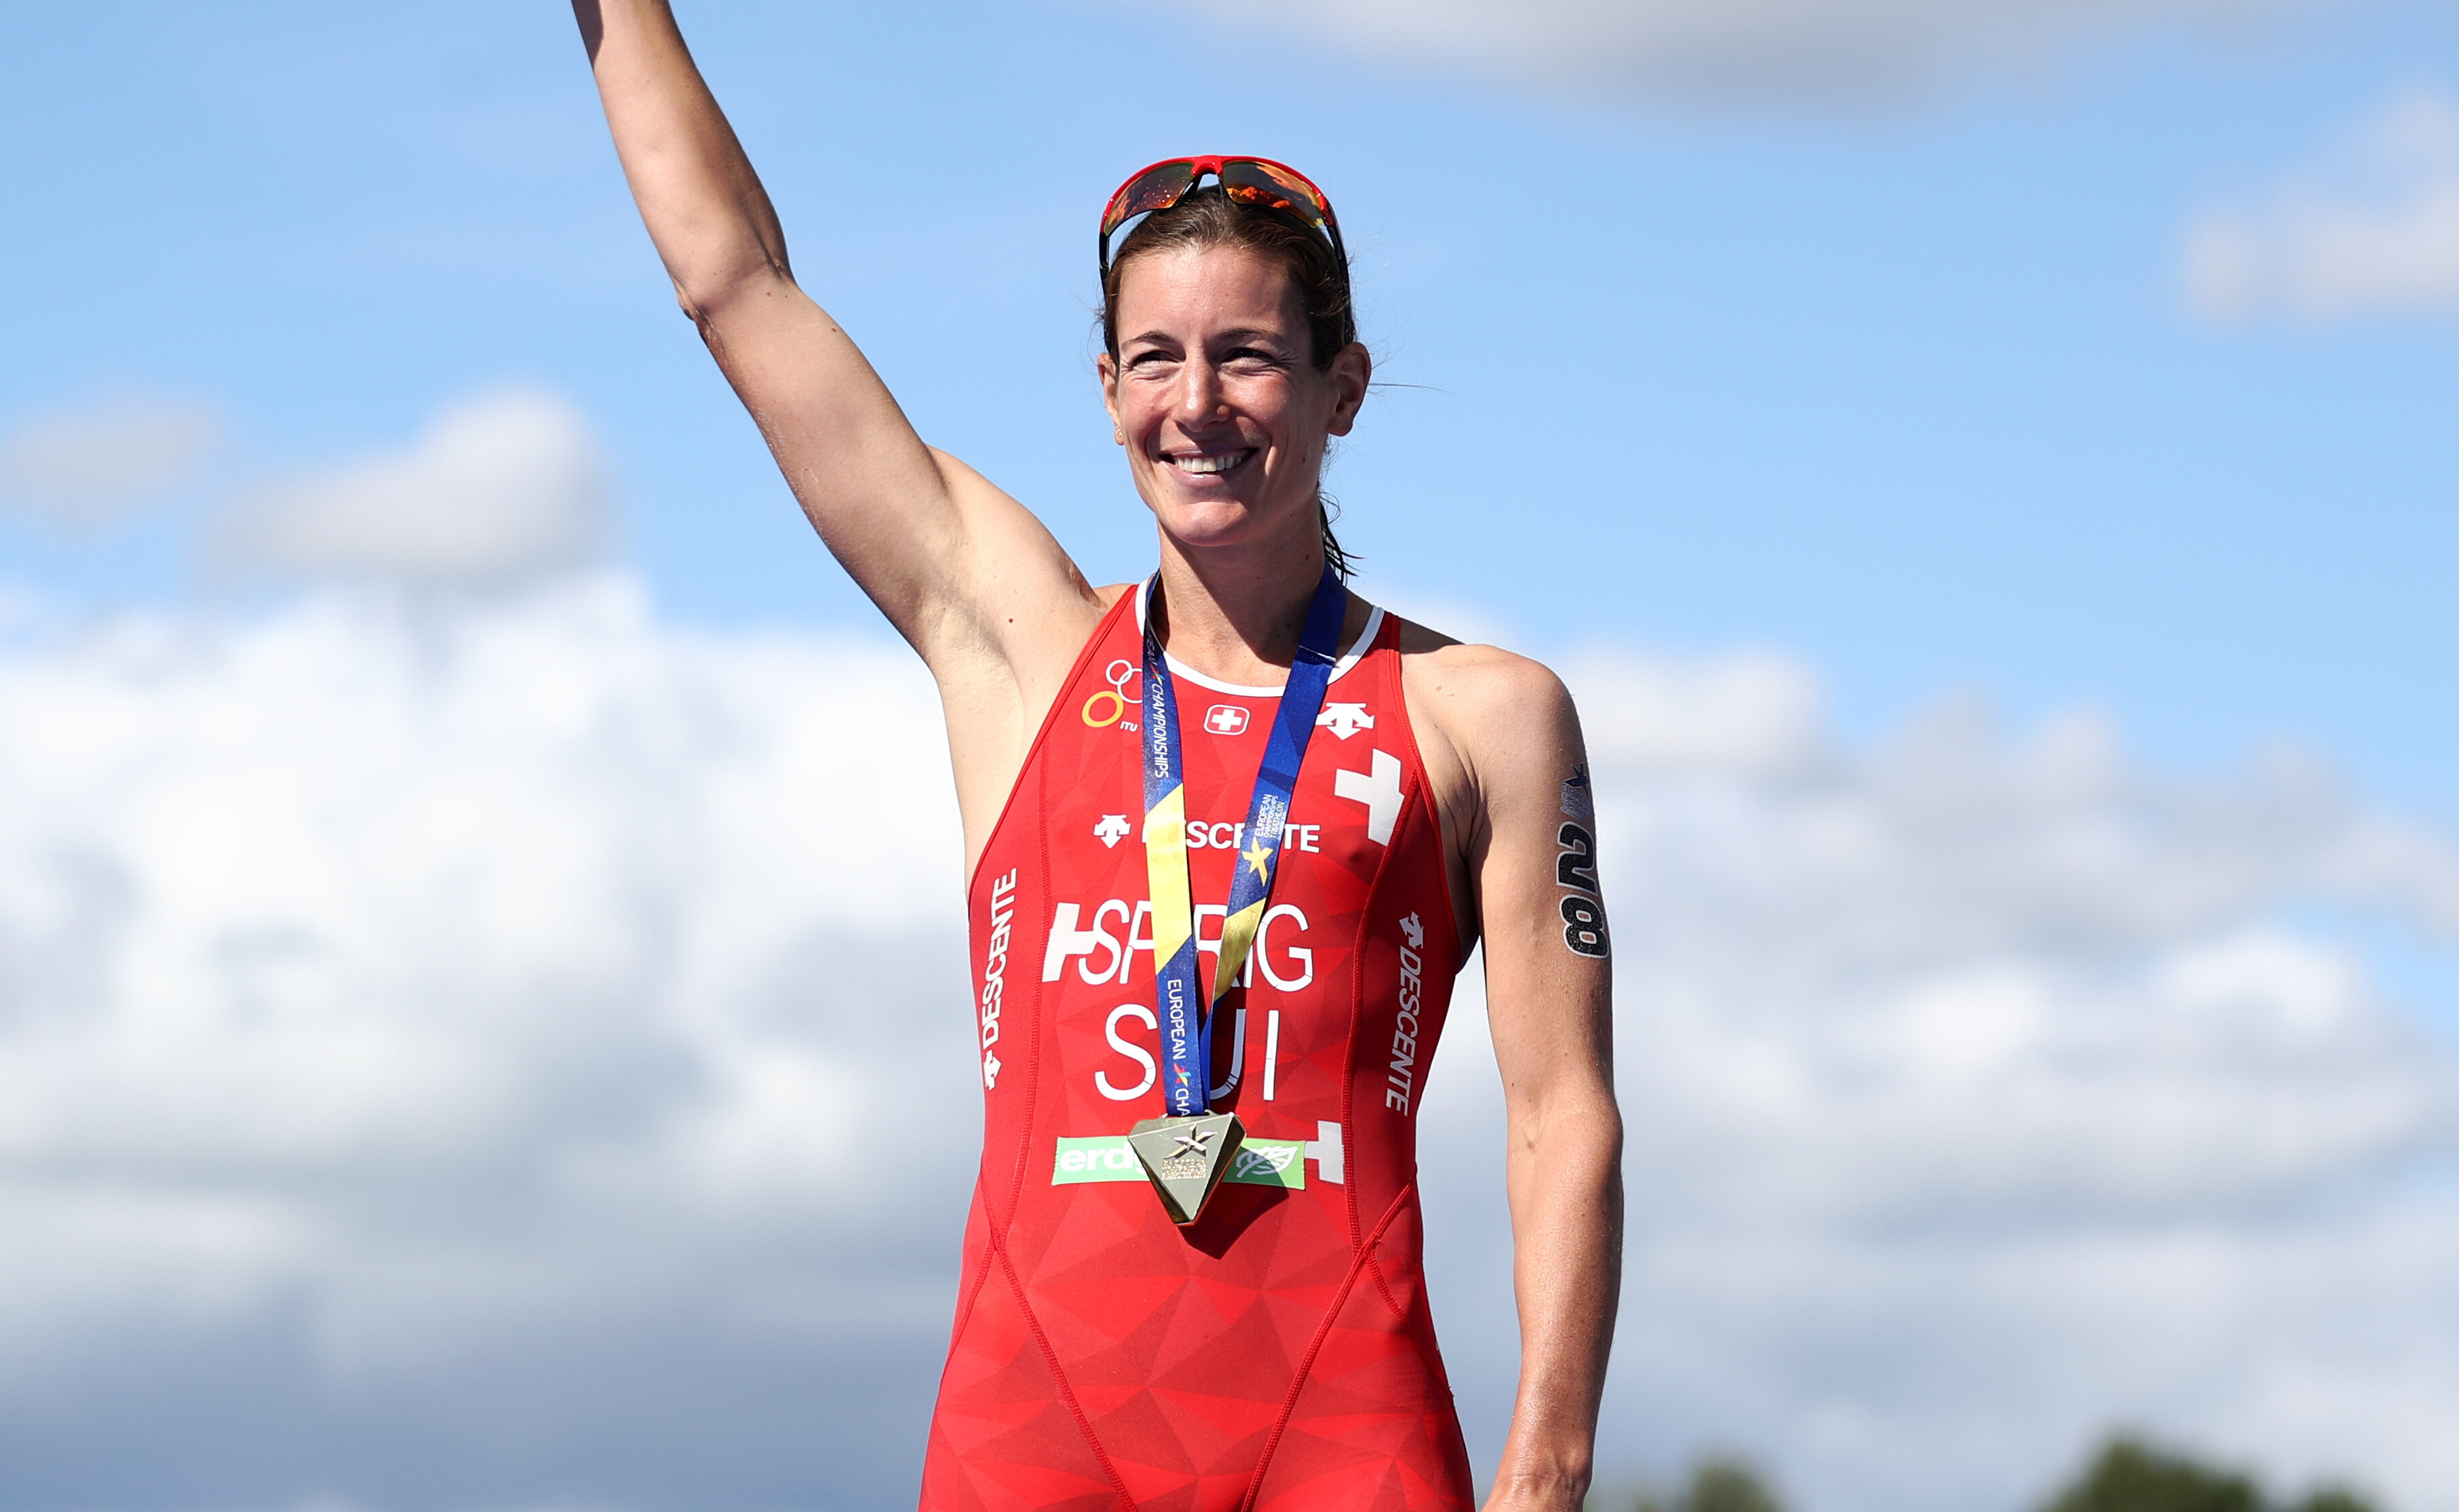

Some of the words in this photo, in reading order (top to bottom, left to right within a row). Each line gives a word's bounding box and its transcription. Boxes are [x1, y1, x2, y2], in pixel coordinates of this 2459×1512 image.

[1120, 720, 1138, 732] ITU
[1152, 682, 1169, 778] CHAMPIONSHIPS
[1254, 794, 1273, 837] EUROPEAN
[1270, 801, 1285, 838] TRIATHLON
[1556, 821, 1609, 958] 28
[982, 868, 1017, 1049] DESCENTE
[1078, 899, 1313, 992] SPRIG
[1167, 979, 1186, 1060] EUROPEAN
[1386, 946, 1422, 1117] DESCENTE
